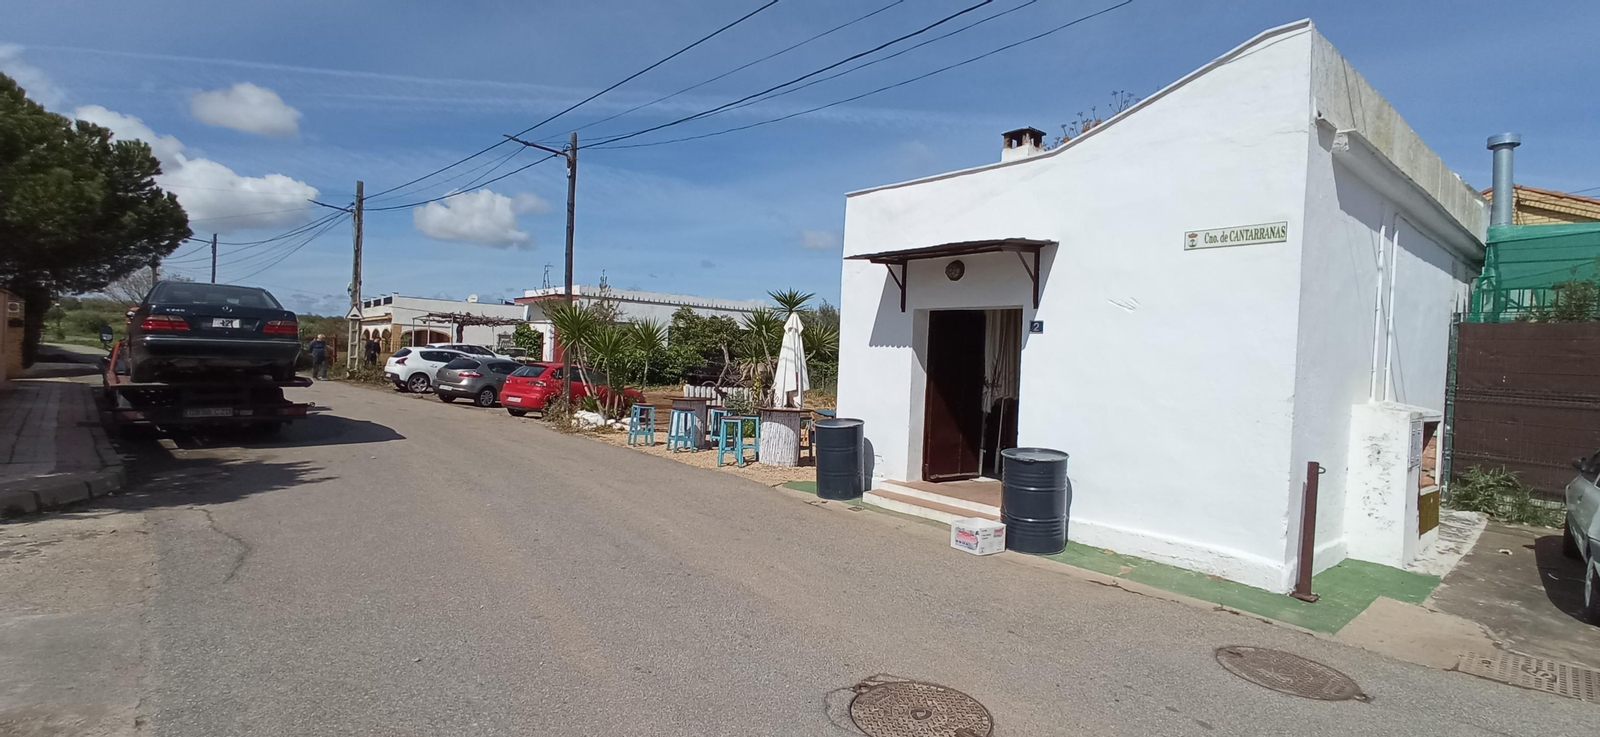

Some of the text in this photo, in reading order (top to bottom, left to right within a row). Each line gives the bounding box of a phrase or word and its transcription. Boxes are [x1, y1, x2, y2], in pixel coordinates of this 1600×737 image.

[1204, 226, 1286, 244] Cno. de CANTARRANAS
[1033, 322, 1040, 332] 2
